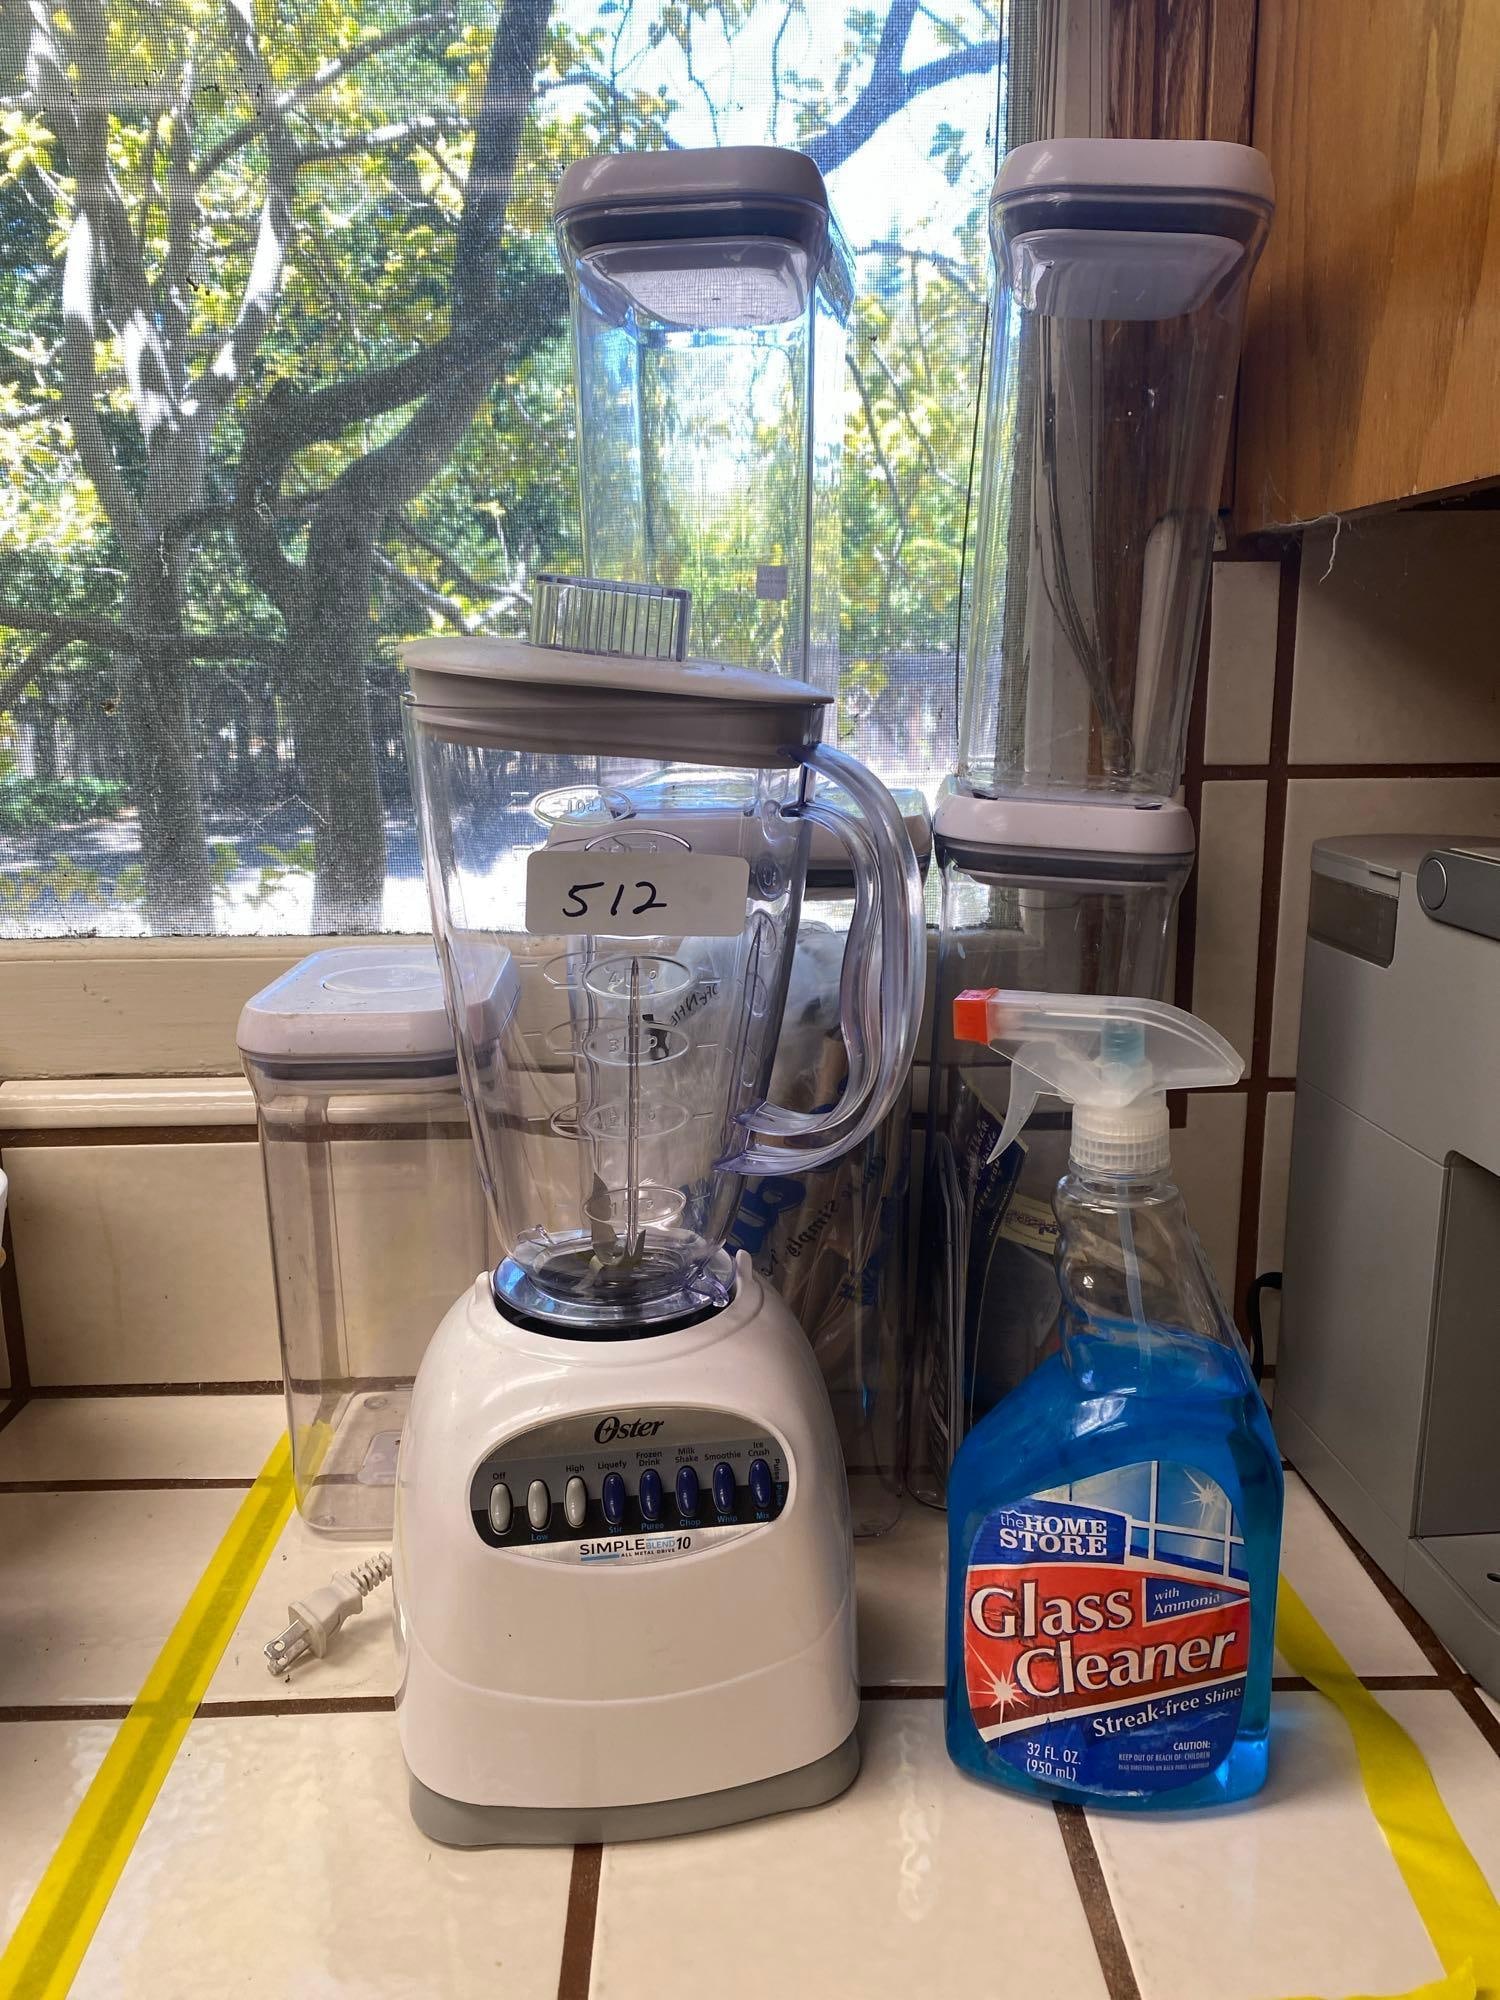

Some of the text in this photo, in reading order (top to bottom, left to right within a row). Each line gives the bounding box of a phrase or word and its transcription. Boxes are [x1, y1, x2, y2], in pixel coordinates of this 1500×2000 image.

[562, 881, 667, 917] 512
[594, 1416, 664, 1444] Oster
[753, 1441, 764, 1449] Ice
[636, 1450, 663, 1459] Frozen
[678, 1447, 695, 1455] Milk
[704, 1450, 741, 1461] Smoothie
[748, 1449, 770, 1457] Crush
[639, 1459, 660, 1467] Drink
[675, 1455, 699, 1463] Shake
[566, 1464, 585, 1473] High
[597, 1460, 627, 1470] Liquefy
[492, 1472, 506, 1480] Off
[717, 1515, 738, 1524] Whip
[756, 1511, 769, 1520] Mix
[641, 1522, 664, 1531] Puree
[680, 1519, 701, 1527] Chop
[608, 1526, 622, 1534] Stir
[531, 1533, 548, 1541] Low
[676, 1536, 692, 1550] 10
[1000, 1529, 1107, 1556] STORE
[1154, 1587, 1180, 1601] with
[1153, 1591, 1222, 1616] Ammonia
[969, 1581, 1134, 1639] Glass
[1015, 1631, 1237, 1698] Cleaner
[1092, 1685, 1242, 1738] Streak-free Shine
[1173, 1740, 1211, 1751] CAUTION:
[1027, 1741, 1081, 1765] 32 FL. OZ.
[1118, 1753, 1133, 1761] KEEP
[1133, 1753, 1145, 1762] OUT
[1155, 1753, 1172, 1762] REACH
[1173, 1753, 1182, 1761] OF
[1026, 1757, 1076, 1782] (950 mL)
